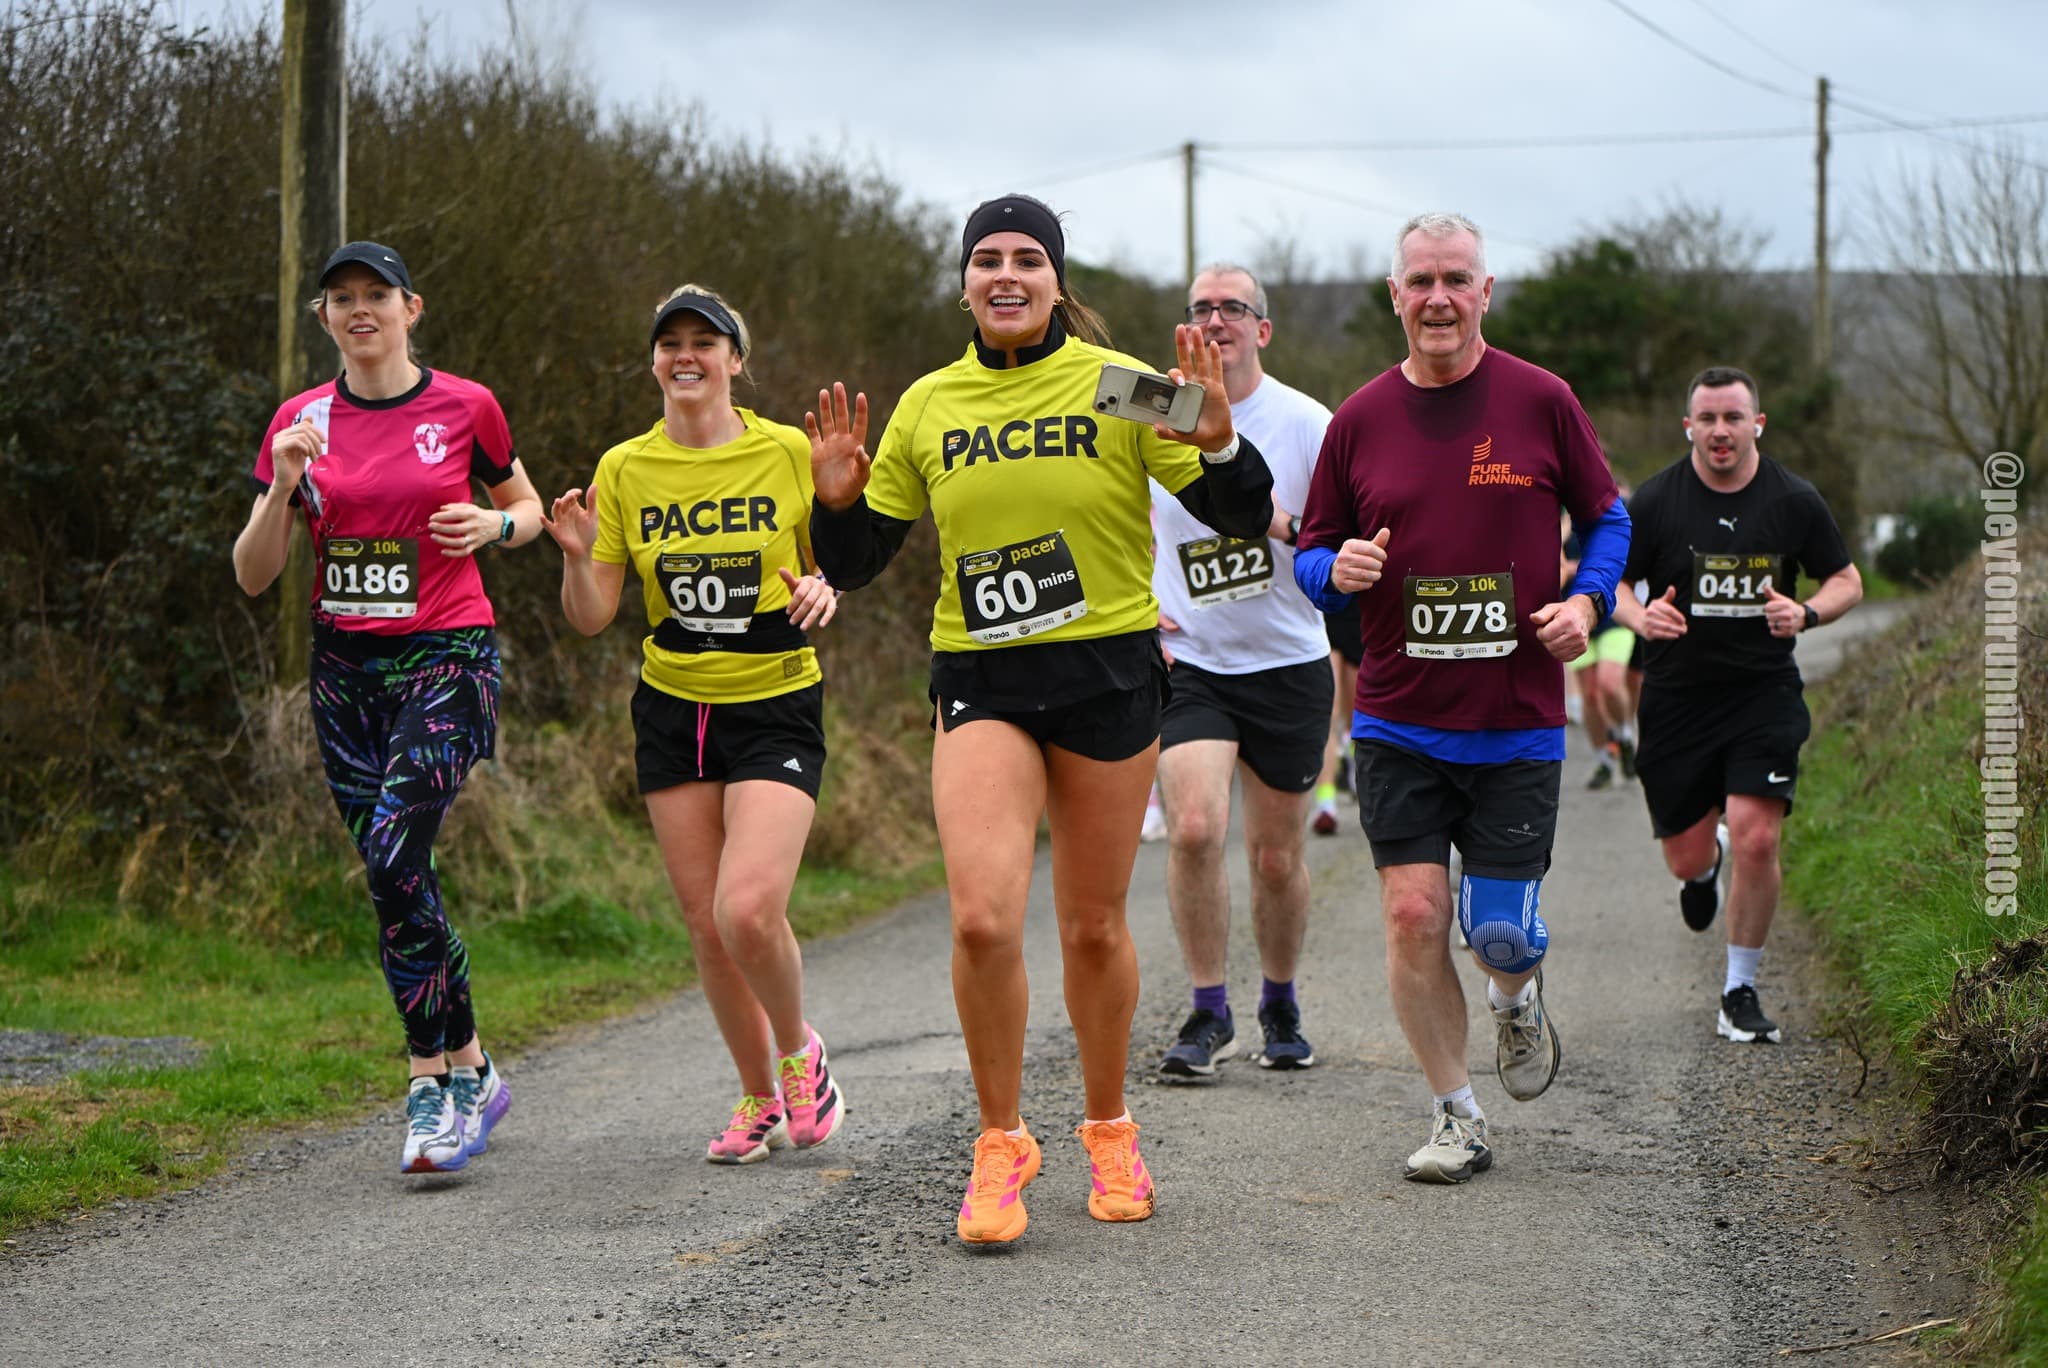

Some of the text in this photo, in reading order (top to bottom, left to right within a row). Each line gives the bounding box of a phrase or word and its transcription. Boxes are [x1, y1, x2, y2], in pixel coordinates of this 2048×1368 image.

[943, 415, 1099, 471] PACER
[1468, 474, 1533, 487] RUNNING
[1470, 463, 1511, 475] PURE
[640, 496, 778, 543] PACER
[373, 541, 401, 554] 10k
[1010, 538, 1057, 565] pacer
[711, 556, 754, 571] pacer
[1189, 547, 1269, 589] 0122
[1748, 557, 1769, 568] 10k
[327, 563, 409, 594] 0186
[1469, 577, 1497, 592] 10k
[1699, 573, 1773, 599] 0414
[670, 575, 759, 613] 60 mins
[975, 569, 1075, 620] 60 mins
[1412, 601, 1507, 634] 0778
[988, 631, 1010, 640] Panda
